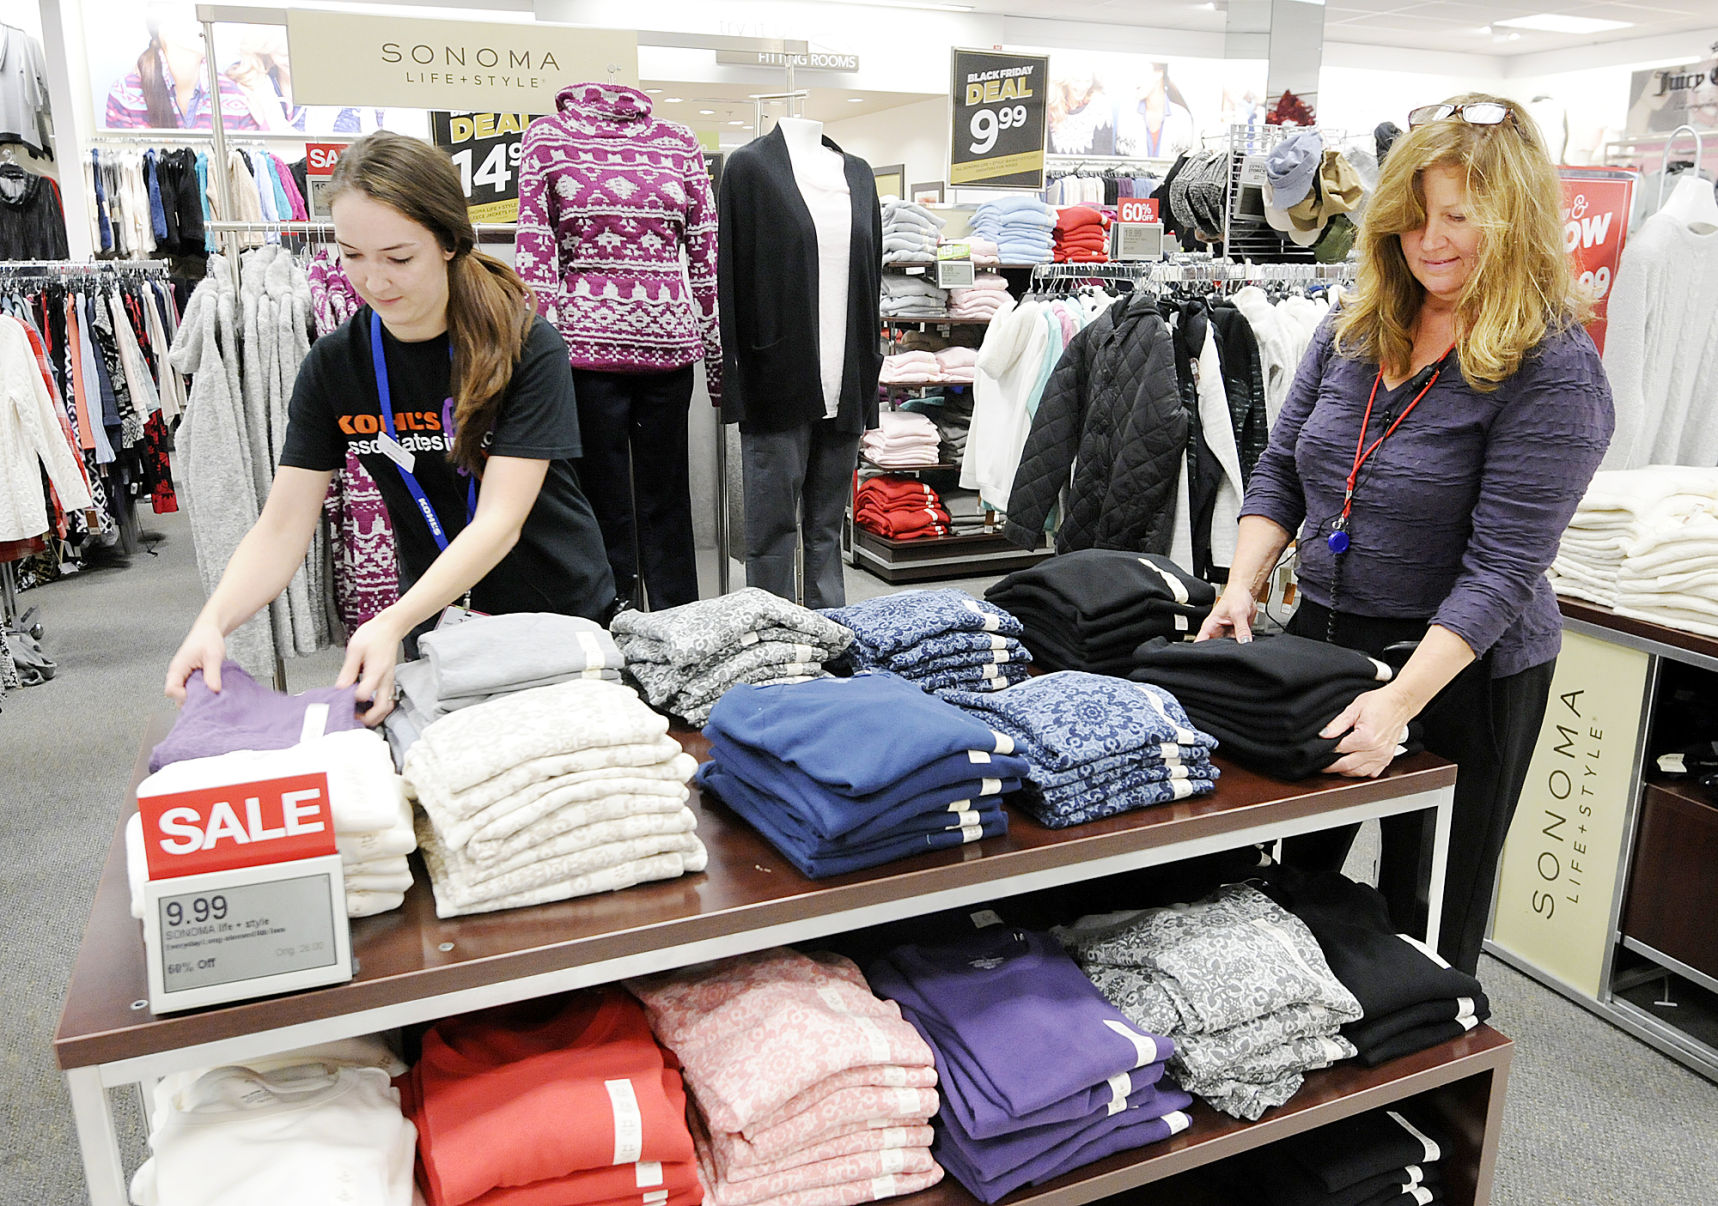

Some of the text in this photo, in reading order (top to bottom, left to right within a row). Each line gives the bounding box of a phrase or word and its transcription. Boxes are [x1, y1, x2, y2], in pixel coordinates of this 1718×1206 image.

[382, 43, 560, 71] SONOMA
[811, 54, 856, 68] ROOMS
[967, 65, 1034, 83] BLACK FRIDAY
[966, 76, 1033, 106] DEAL
[310, 148, 339, 168] SA
[1122, 202, 1152, 221] 60%
[1563, 212, 1613, 254] OW
[338, 411, 441, 435] KOHL'S
[1532, 689, 1585, 920] SONOMA
[158, 788, 325, 855] SALE
[166, 895, 228, 926] 9.99
[166, 924, 215, 941] SONOMA
[245, 918, 270, 930] style
[197, 957, 217, 969] Off
